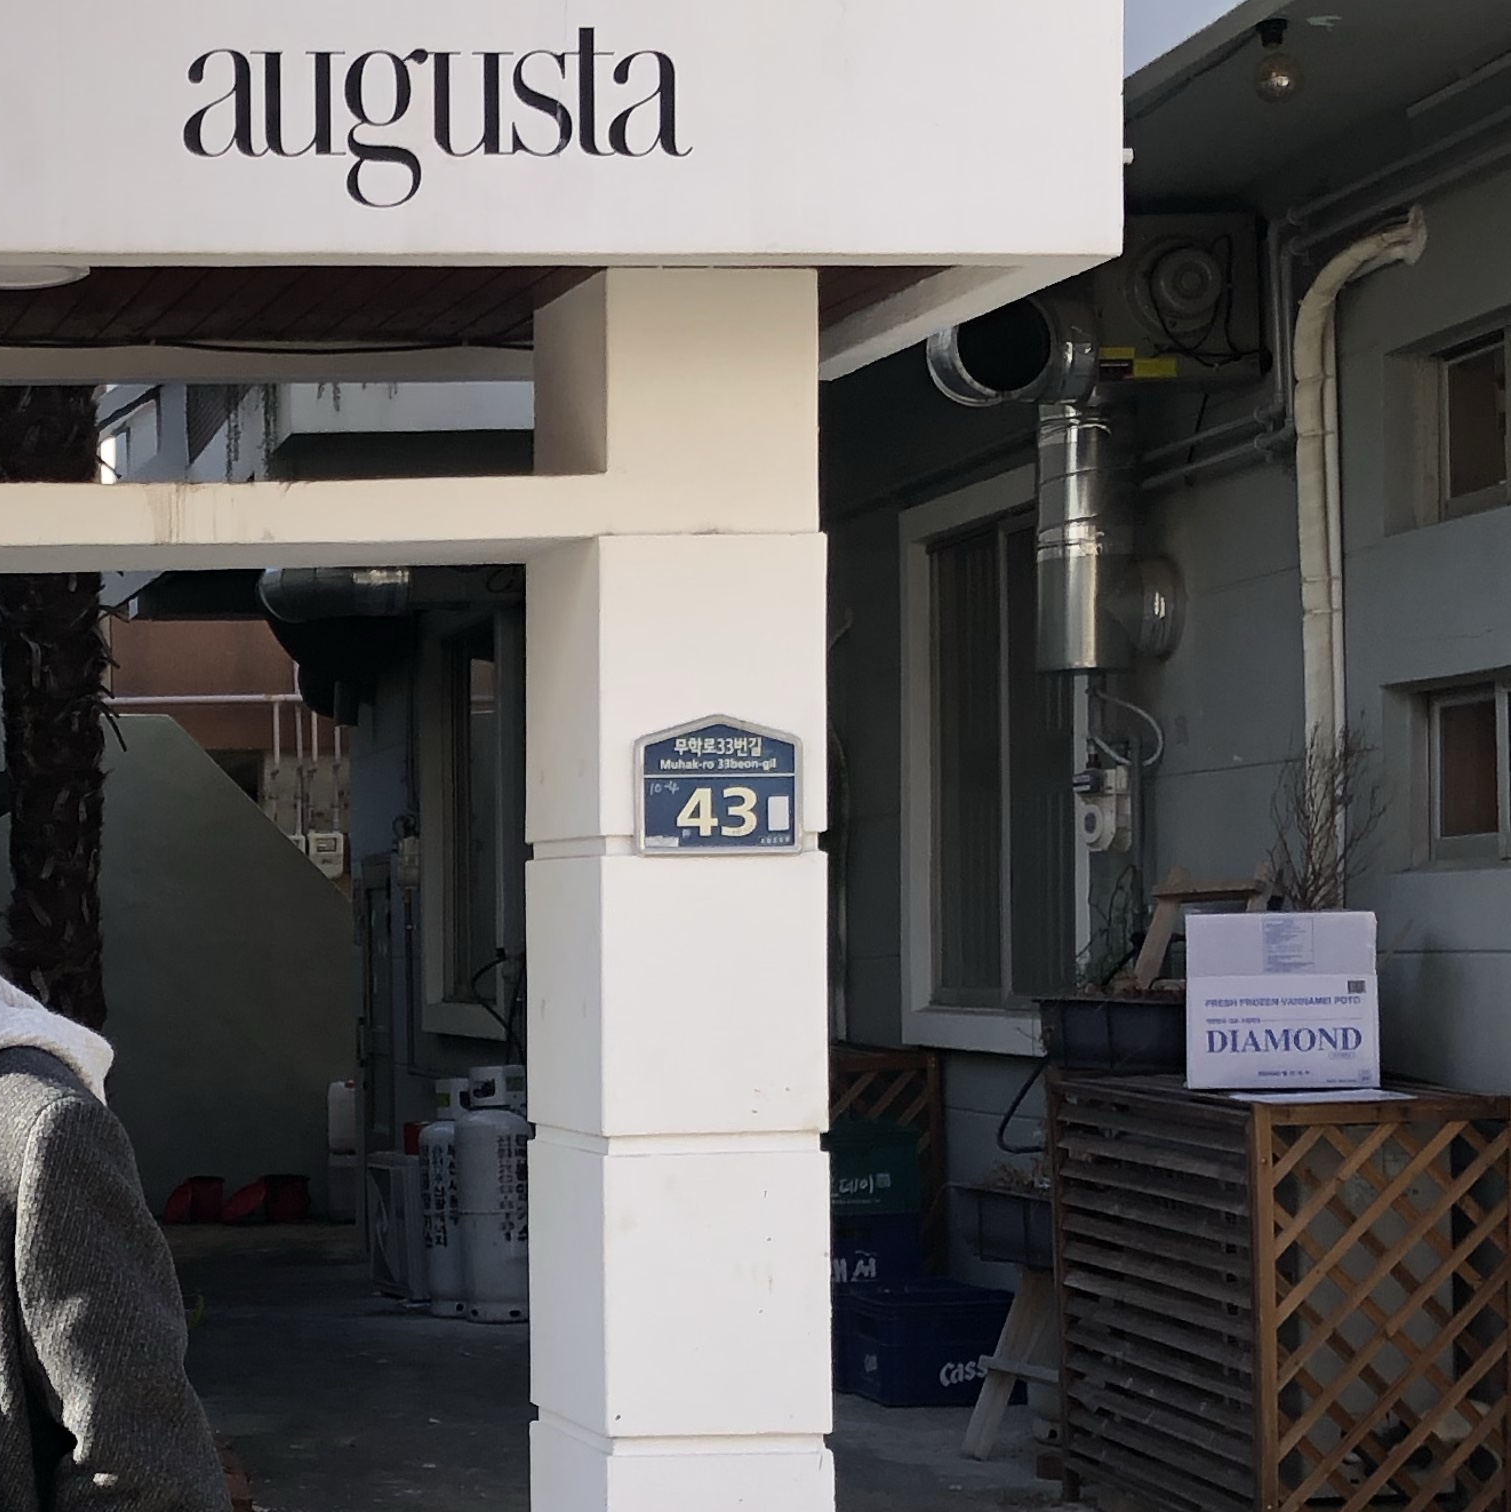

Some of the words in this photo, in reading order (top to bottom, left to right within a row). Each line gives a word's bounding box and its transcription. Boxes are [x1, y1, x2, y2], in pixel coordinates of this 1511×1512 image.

[183, 27, 693, 208] augusta
[674, 737, 762, 757] 무학로33번길
[660, 758, 714, 770] Muhak-ro
[717, 757, 777, 772] 33beon-gil
[676, 786, 758, 837] 43
[1205, 998, 1238, 1008] FRESH
[1206, 1027, 1363, 1053] DIAMOND
